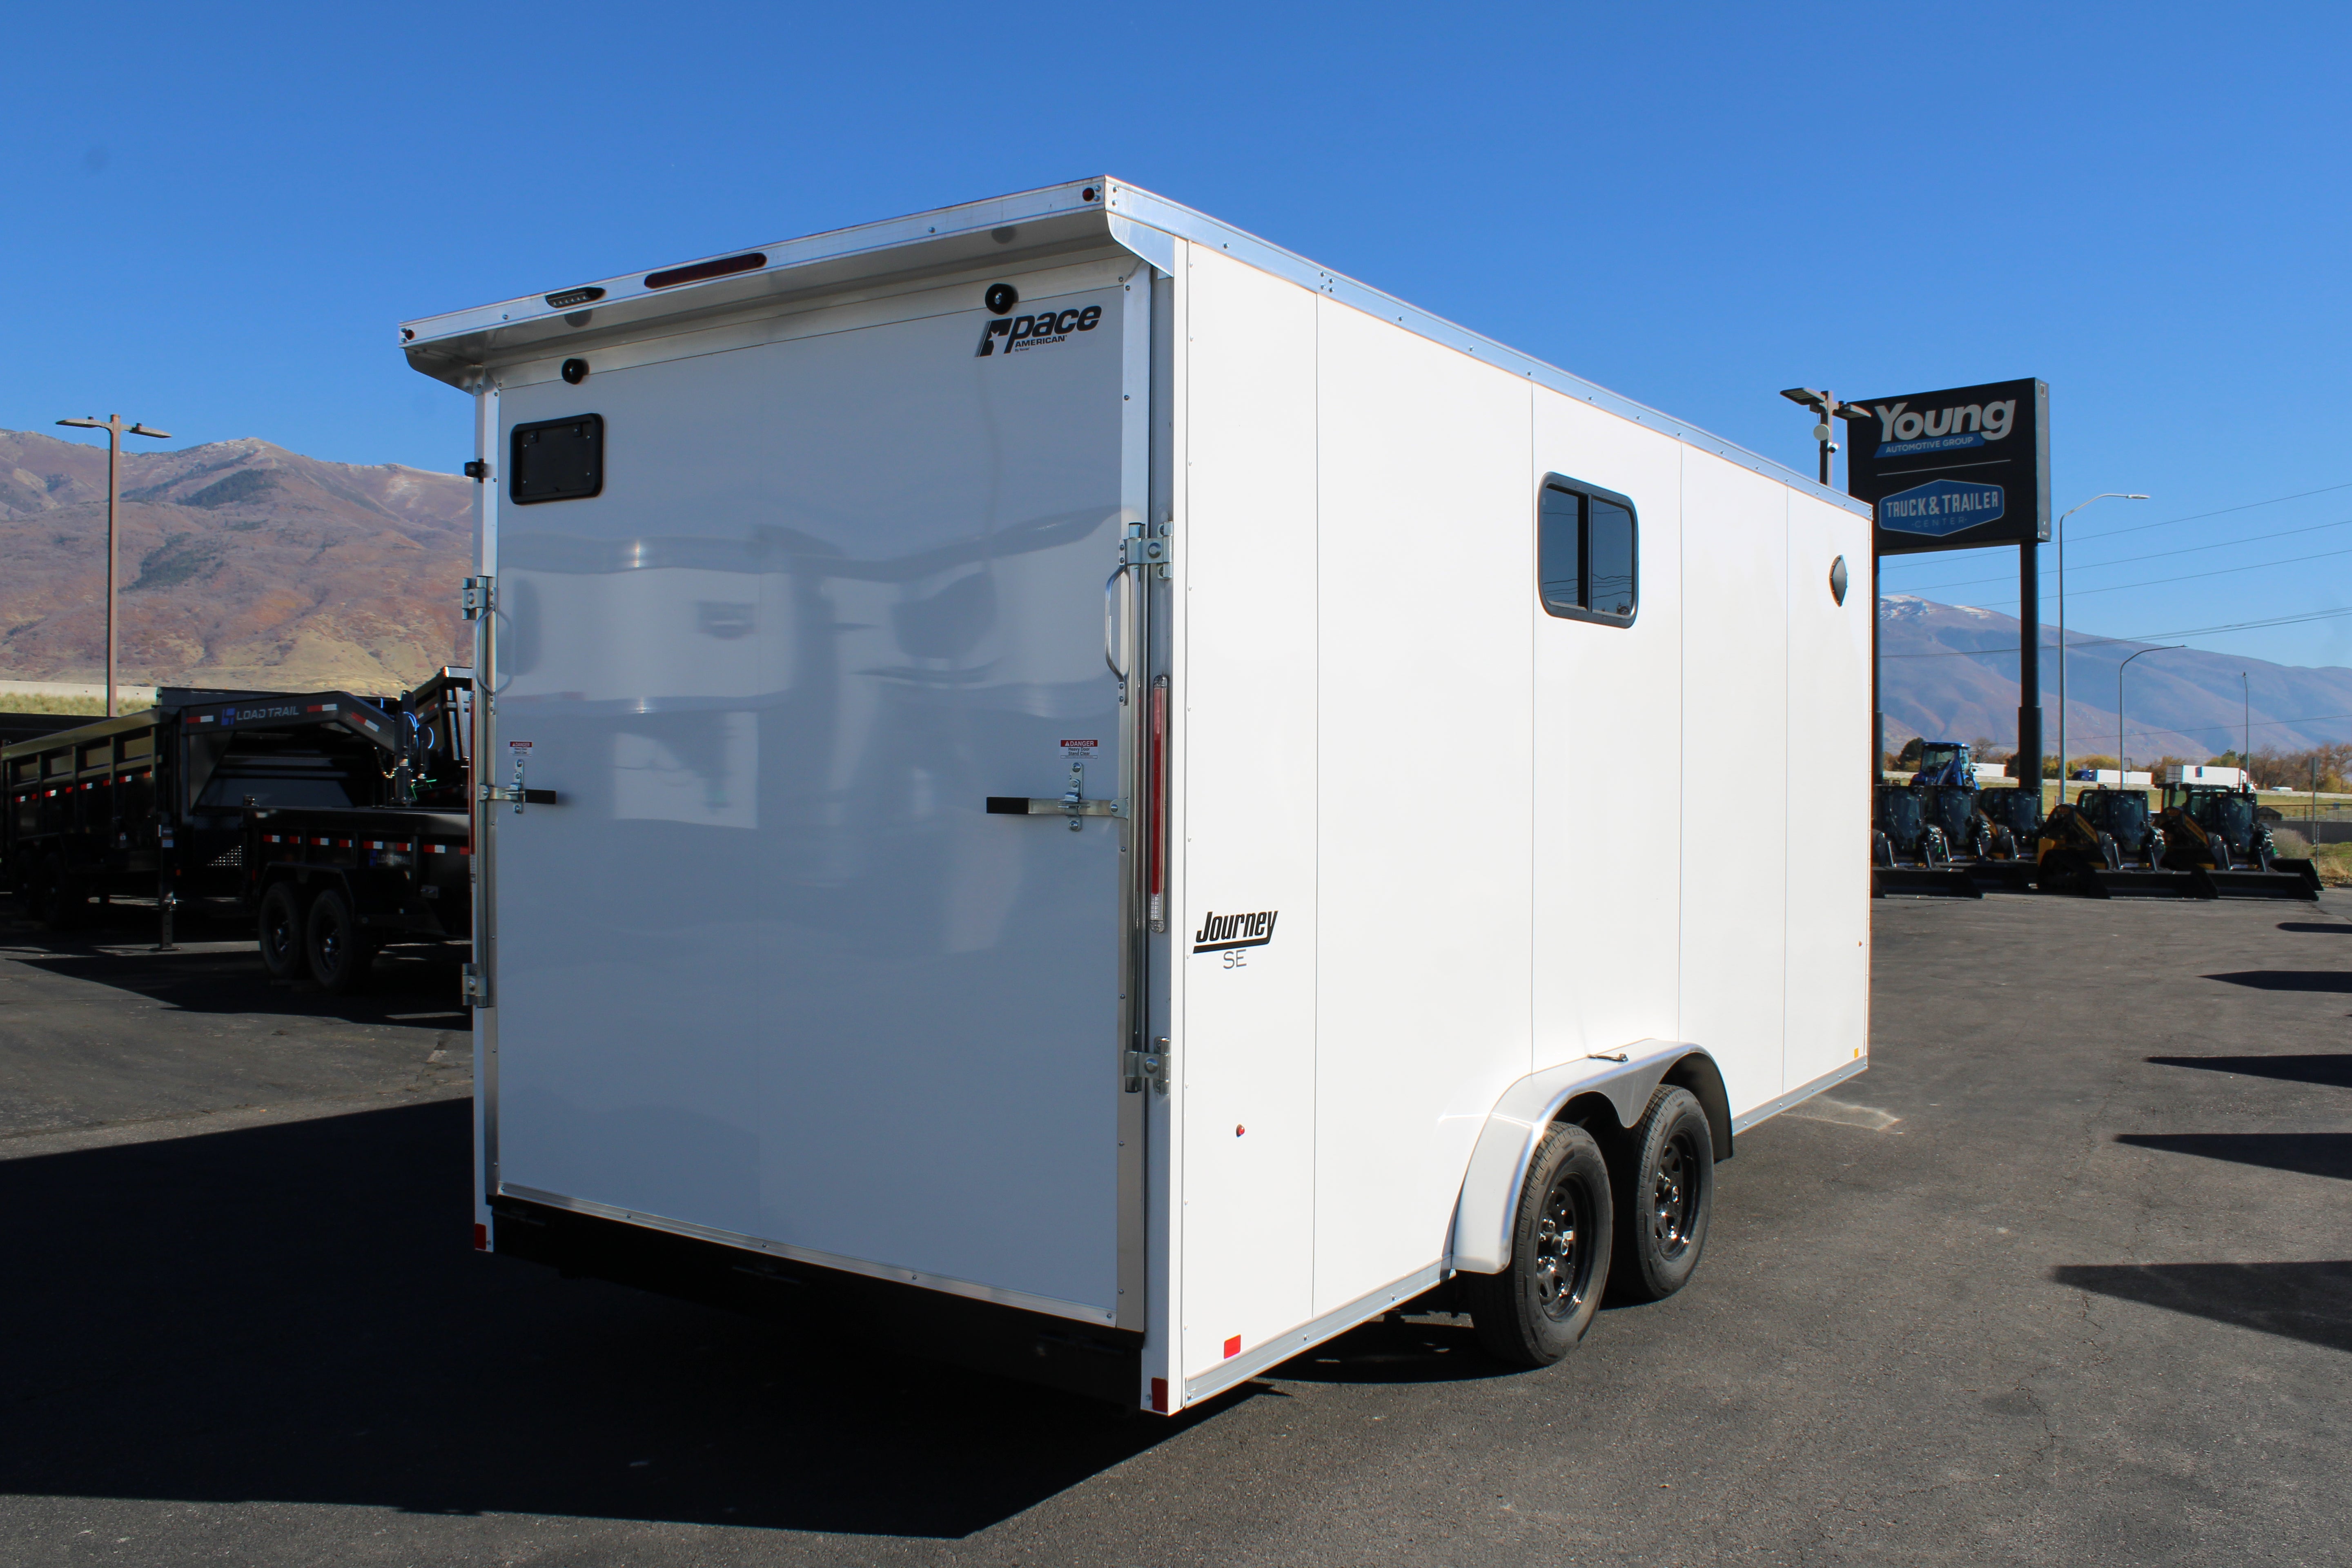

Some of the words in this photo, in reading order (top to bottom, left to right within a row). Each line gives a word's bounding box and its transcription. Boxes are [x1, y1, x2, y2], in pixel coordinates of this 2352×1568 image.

[1004, 305, 1102, 354] pace
[1015, 335, 1065, 348] AMERICAN
[1874, 399, 2016, 442] Young
[1885, 440, 1941, 453] AUTOMOTIVE
[1943, 437, 1973, 447] GROUP
[1886, 497, 1927, 517] TRUCK
[1929, 496, 1940, 515] &
[1942, 491, 1998, 513] TRAILER
[1914, 516, 1965, 528] CENTER
[236, 709, 266, 720] LOAD
[268, 706, 300, 717] TRAIL
[1193, 910, 1278, 954] Journey
[1223, 949, 1247, 969] SE
